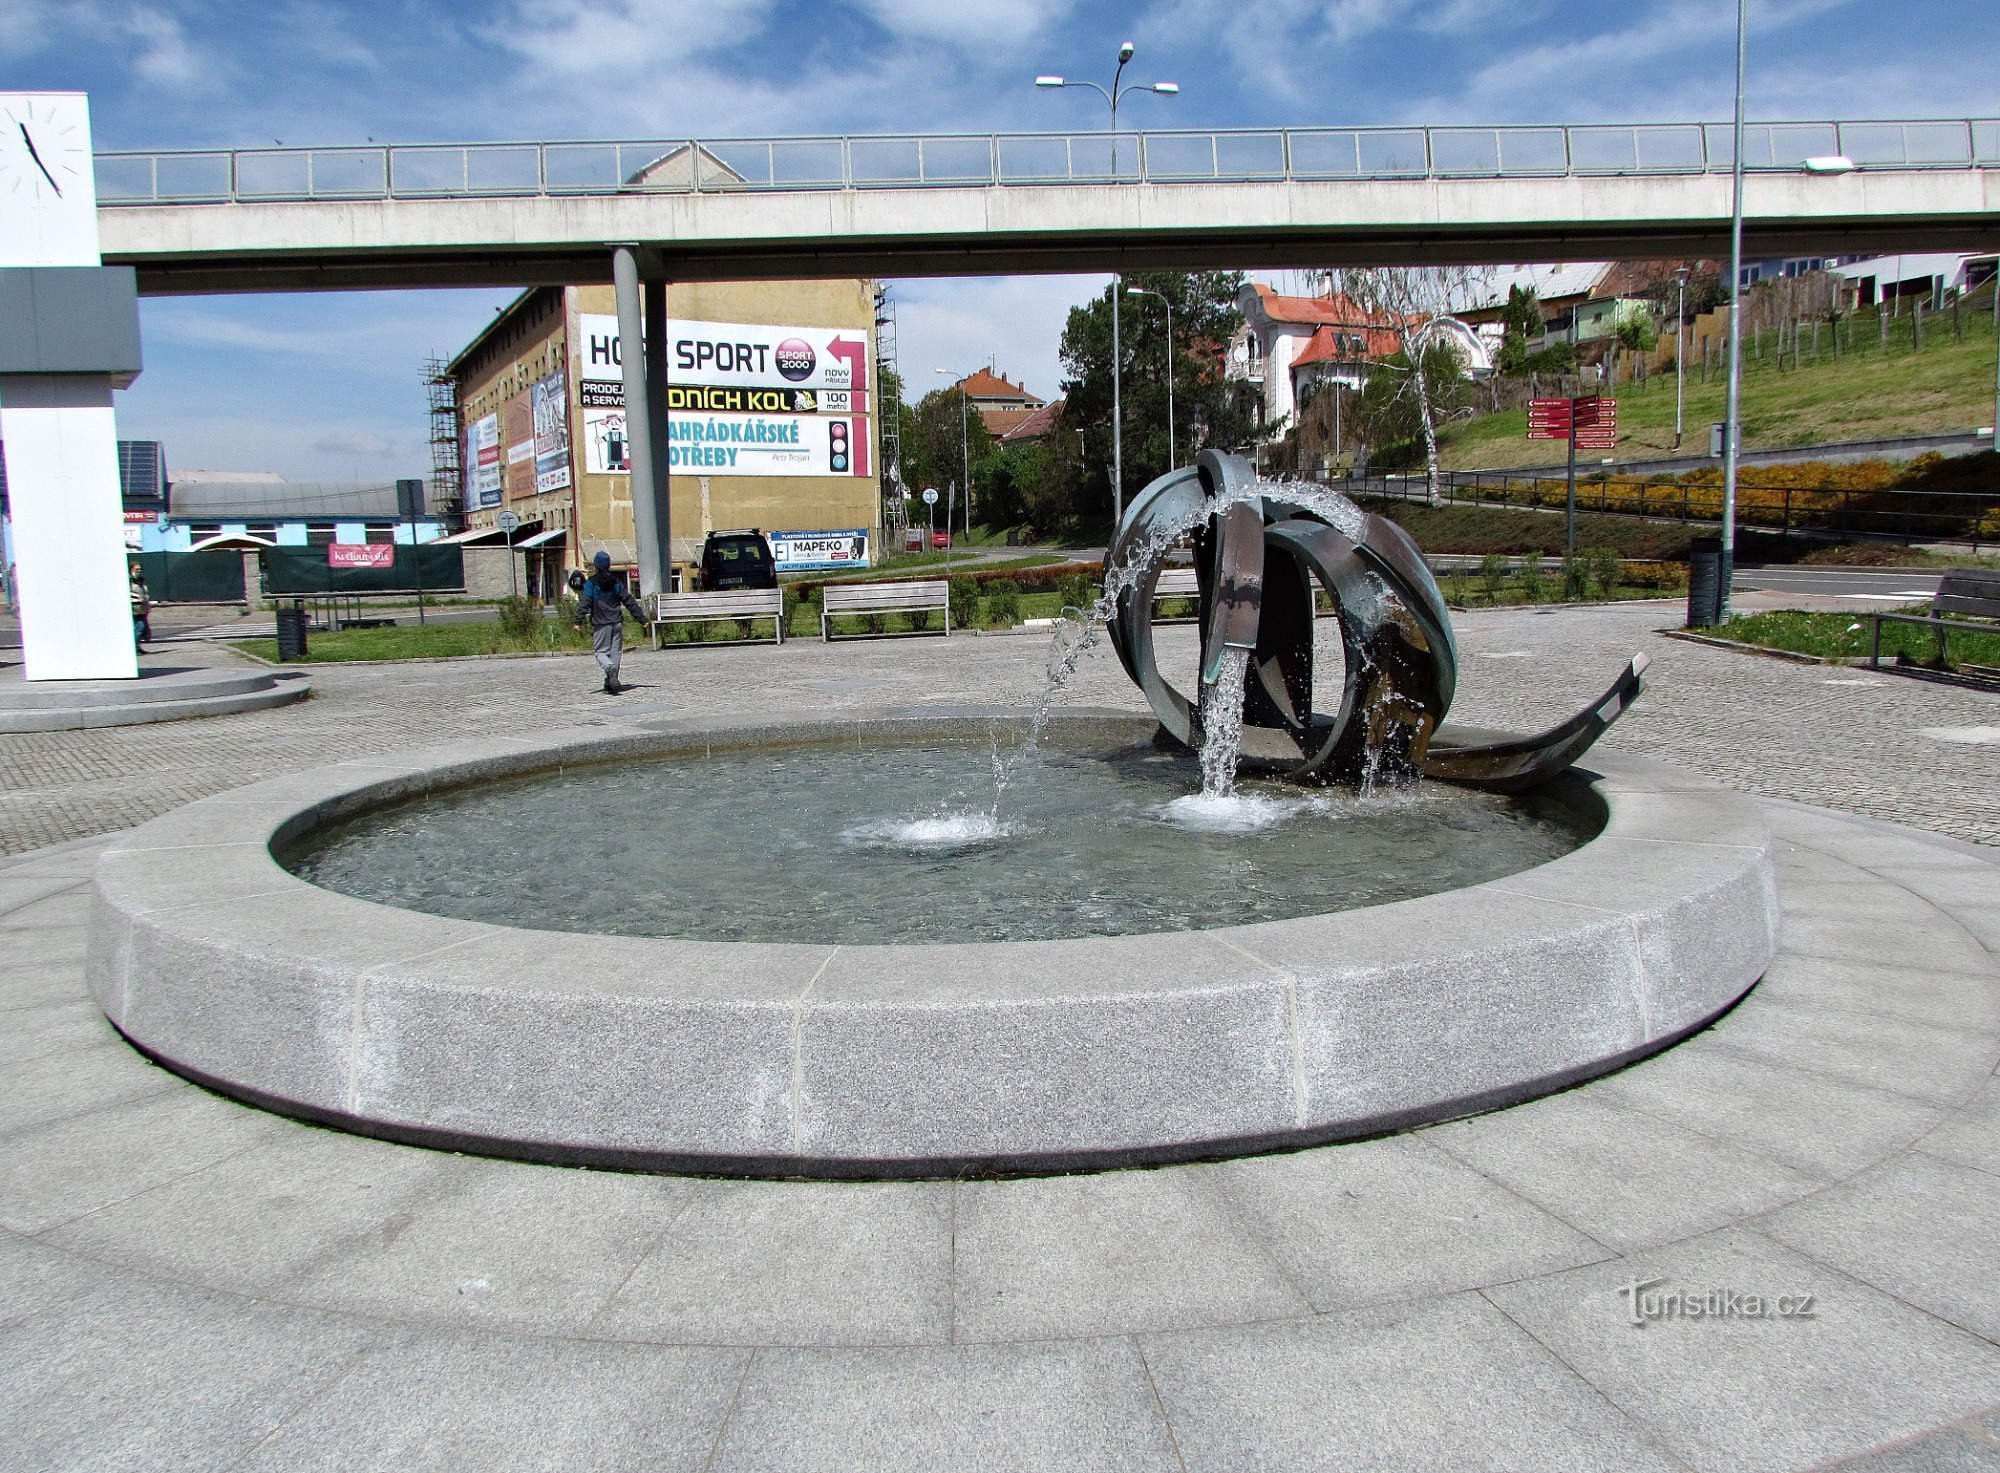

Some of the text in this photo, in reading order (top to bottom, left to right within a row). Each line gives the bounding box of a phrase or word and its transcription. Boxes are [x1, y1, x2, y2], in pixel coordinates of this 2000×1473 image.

[676, 340, 770, 373] SPORT
[778, 350, 812, 360] SPORT
[781, 360, 810, 369] 2000
[582, 383, 624, 394] PRODEJ
[583, 395, 591, 404] A
[747, 391, 792, 411] KOL
[825, 392, 848, 403] 100
[669, 417, 799, 444] AHRÁDKÁŘSKÉ
[669, 441, 738, 467] OTŘEBY
[793, 540, 842, 552] MAPEKO
